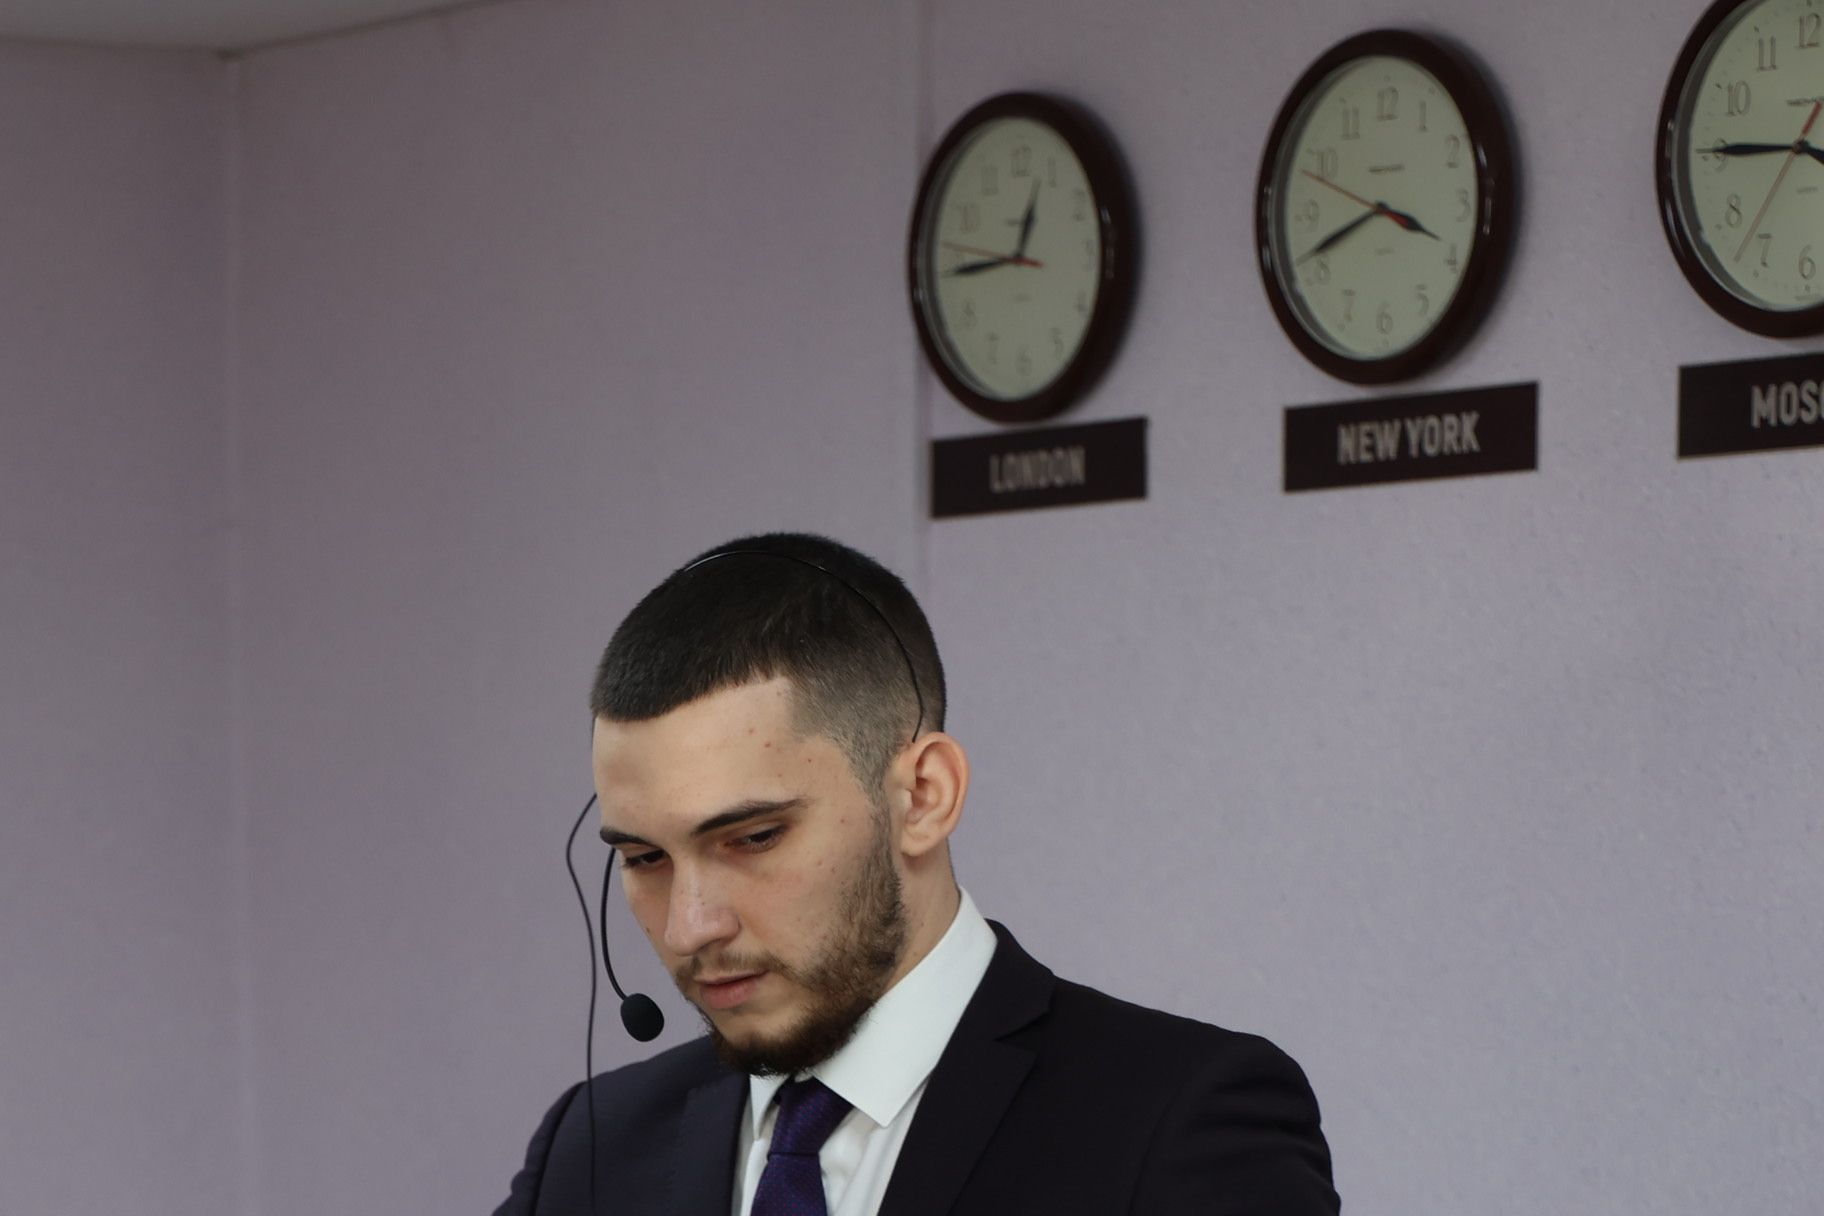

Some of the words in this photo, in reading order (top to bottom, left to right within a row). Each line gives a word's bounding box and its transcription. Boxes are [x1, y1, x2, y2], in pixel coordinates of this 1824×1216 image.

[1726, 192, 1743, 228] 8
[1758, 232, 1772, 268] 7
[1798, 244, 1816, 280] 6
[1751, 379, 1824, 428] MOS
[1337, 418, 1401, 465] NEW
[1403, 410, 1480, 459] YORK
[989, 445, 1085, 493] LONDON
